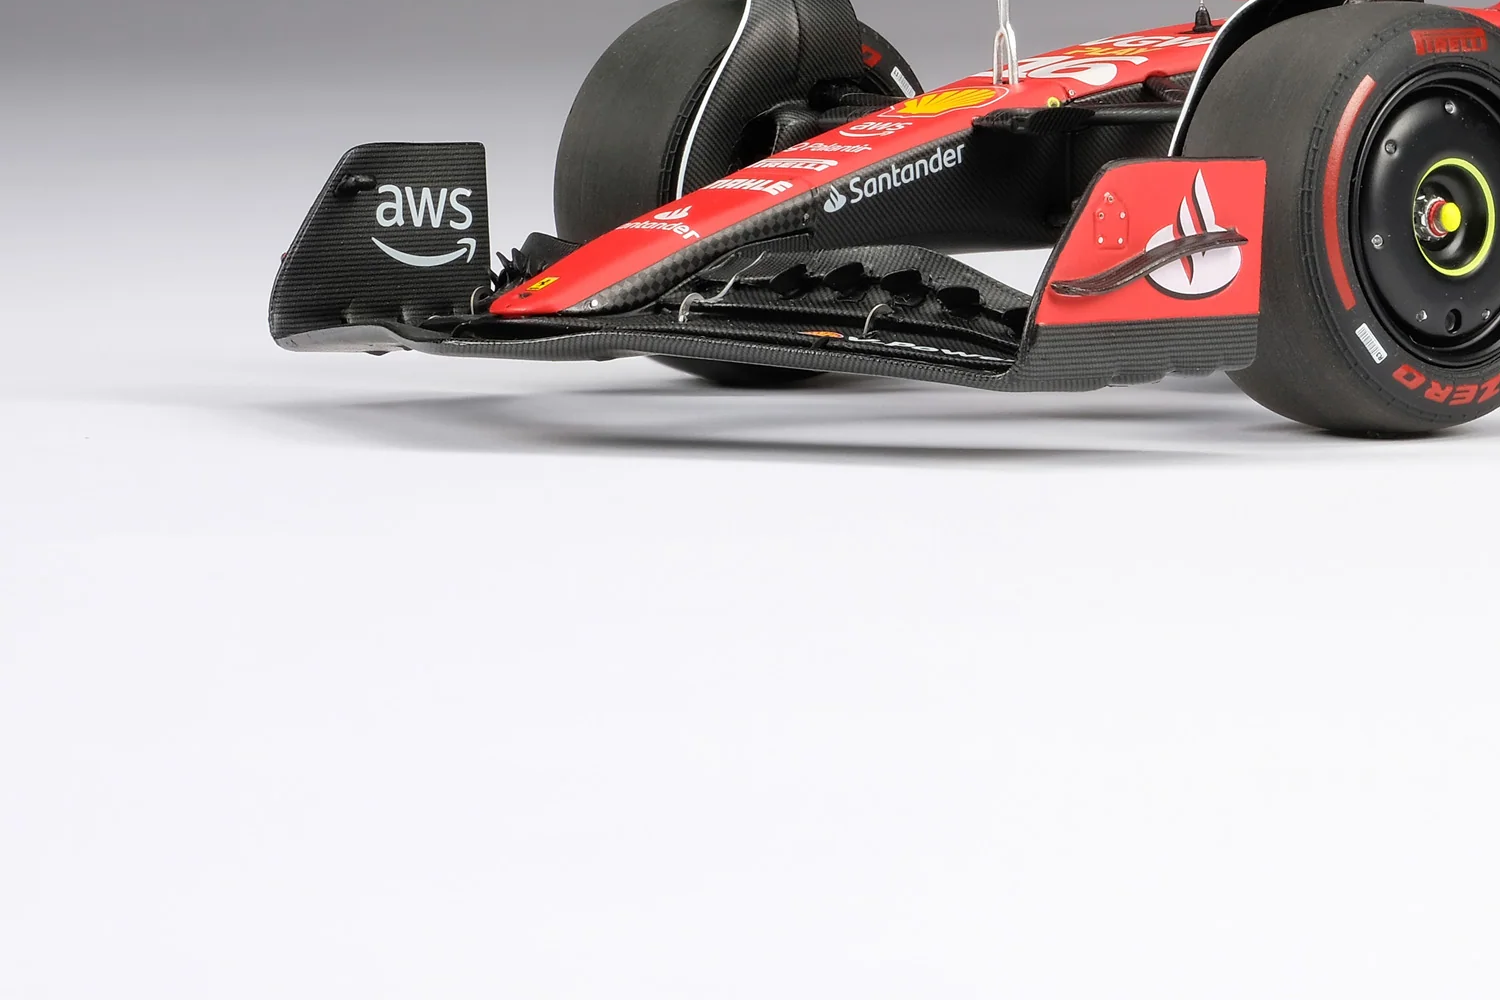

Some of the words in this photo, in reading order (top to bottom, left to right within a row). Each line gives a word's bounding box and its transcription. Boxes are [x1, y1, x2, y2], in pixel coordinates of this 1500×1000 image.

[1410, 27, 1488, 56] PIRELLI
[850, 121, 914, 132] aws
[848, 144, 966, 204] Santander
[702, 178, 794, 196] MAHLE
[375, 183, 473, 230] aws
[616, 220, 700, 240] antander
